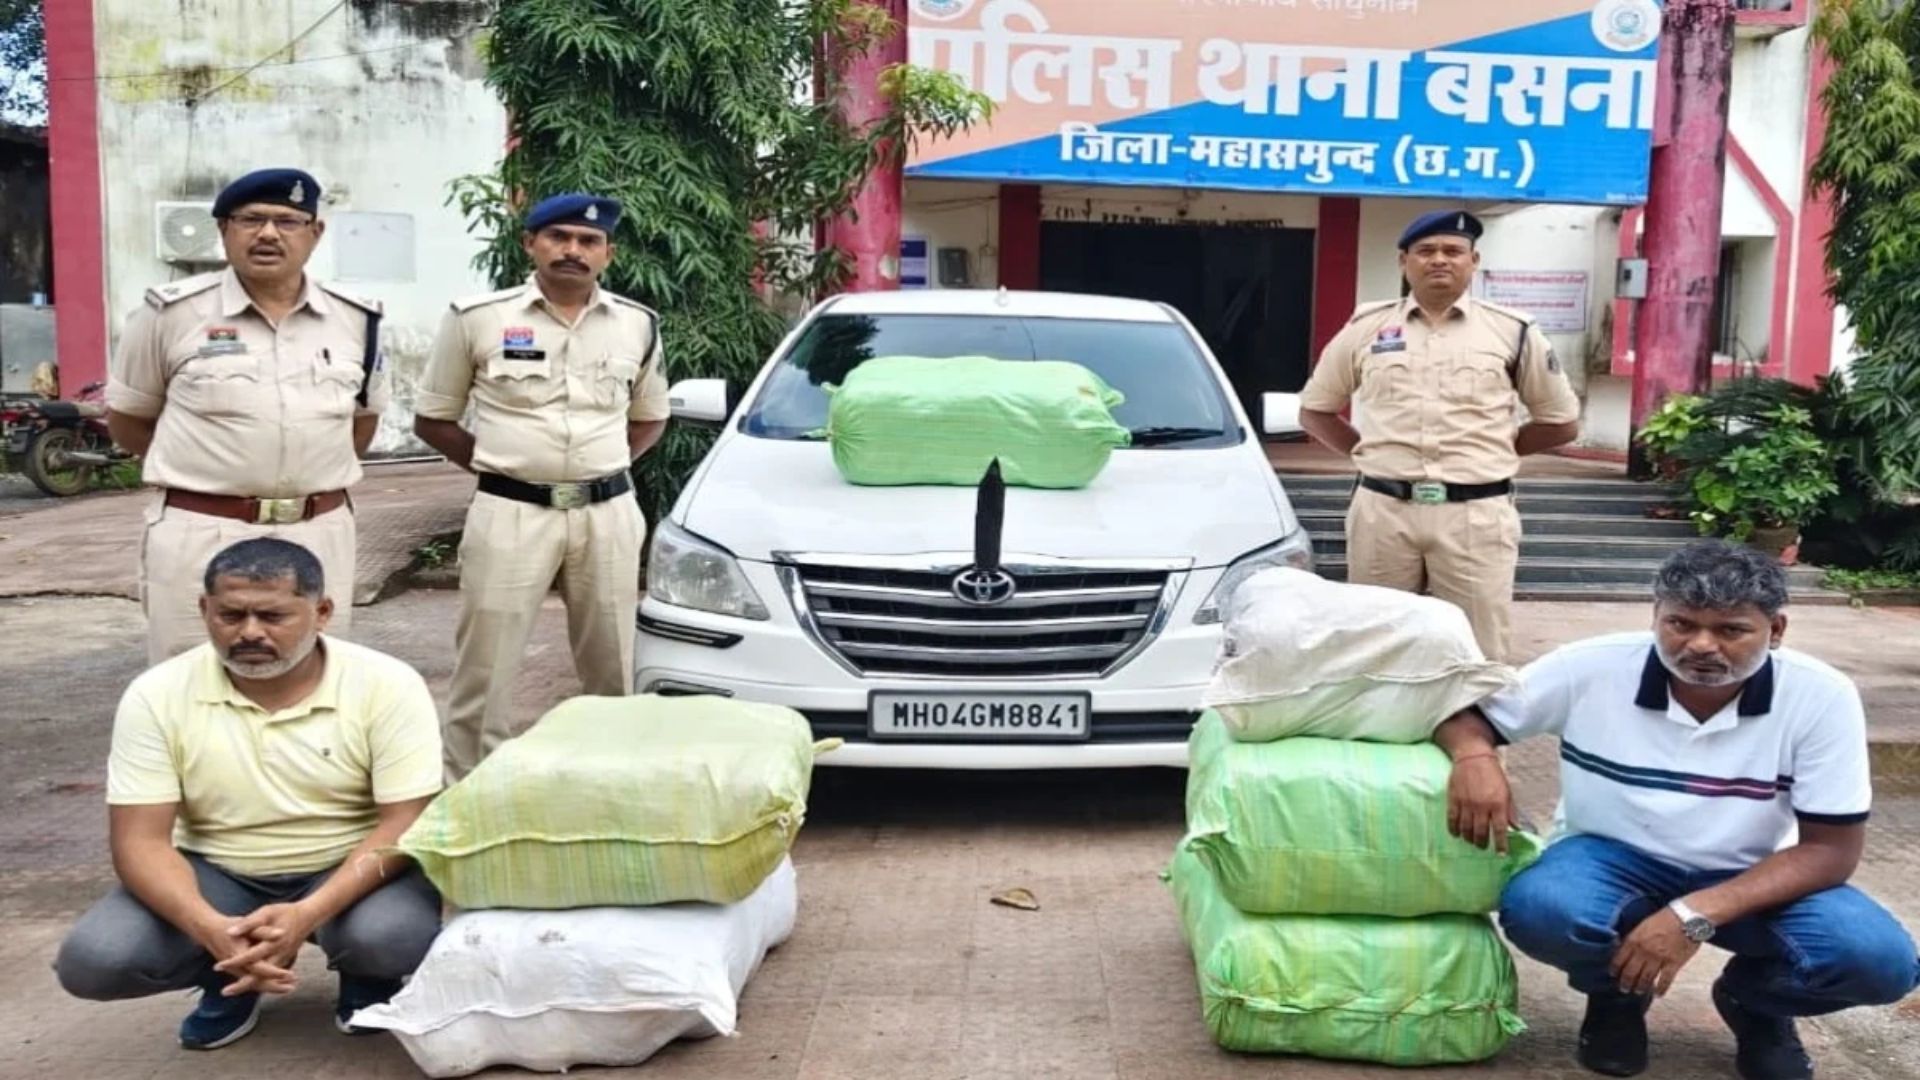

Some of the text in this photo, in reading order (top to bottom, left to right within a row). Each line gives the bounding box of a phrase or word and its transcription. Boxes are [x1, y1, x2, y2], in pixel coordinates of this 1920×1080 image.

[1197, 37, 1410, 119] थाना
[1425, 51, 1657, 130] बसना
[1060, 123, 1535, 188] जिला-महासमुन्द (छ.ग.)
[893, 702, 1079, 728] MH04GM8841
